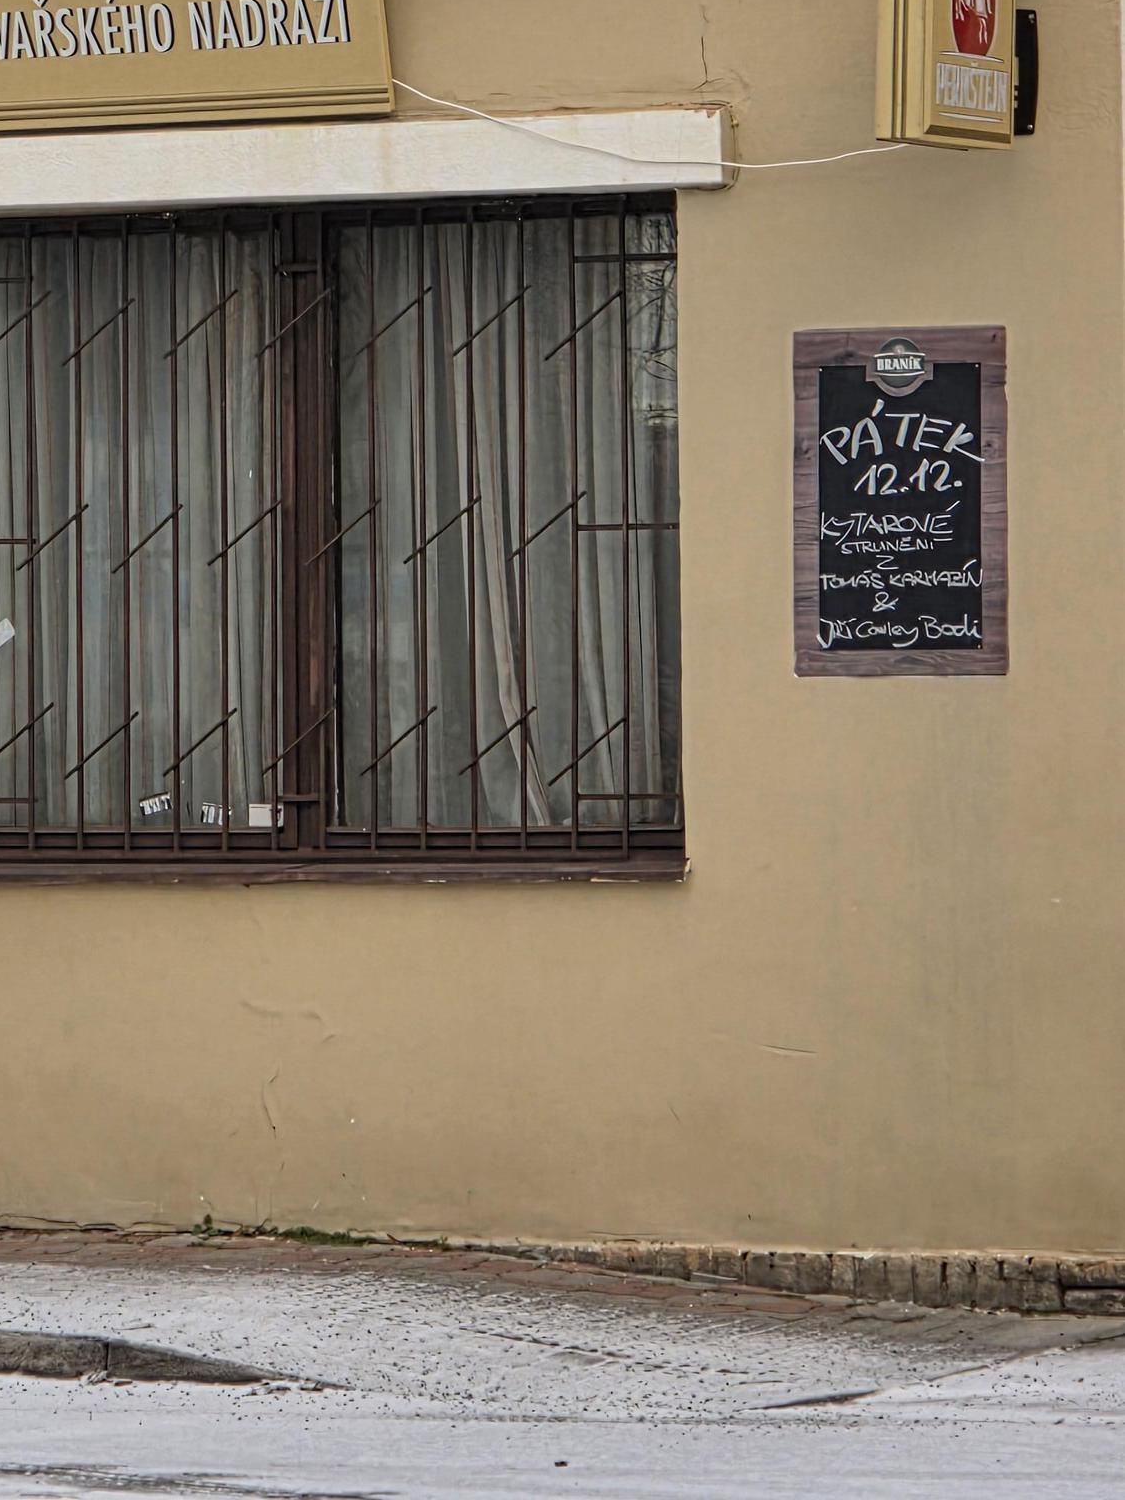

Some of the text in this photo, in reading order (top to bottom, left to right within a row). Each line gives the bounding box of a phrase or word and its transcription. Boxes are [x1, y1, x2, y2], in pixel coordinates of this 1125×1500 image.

[936, 62, 1009, 112] PERNŠTEJN
[877, 356, 922, 371] BRANÍK
[820, 399, 985, 464] PÁTEK
[873, 592, 899, 612] &
